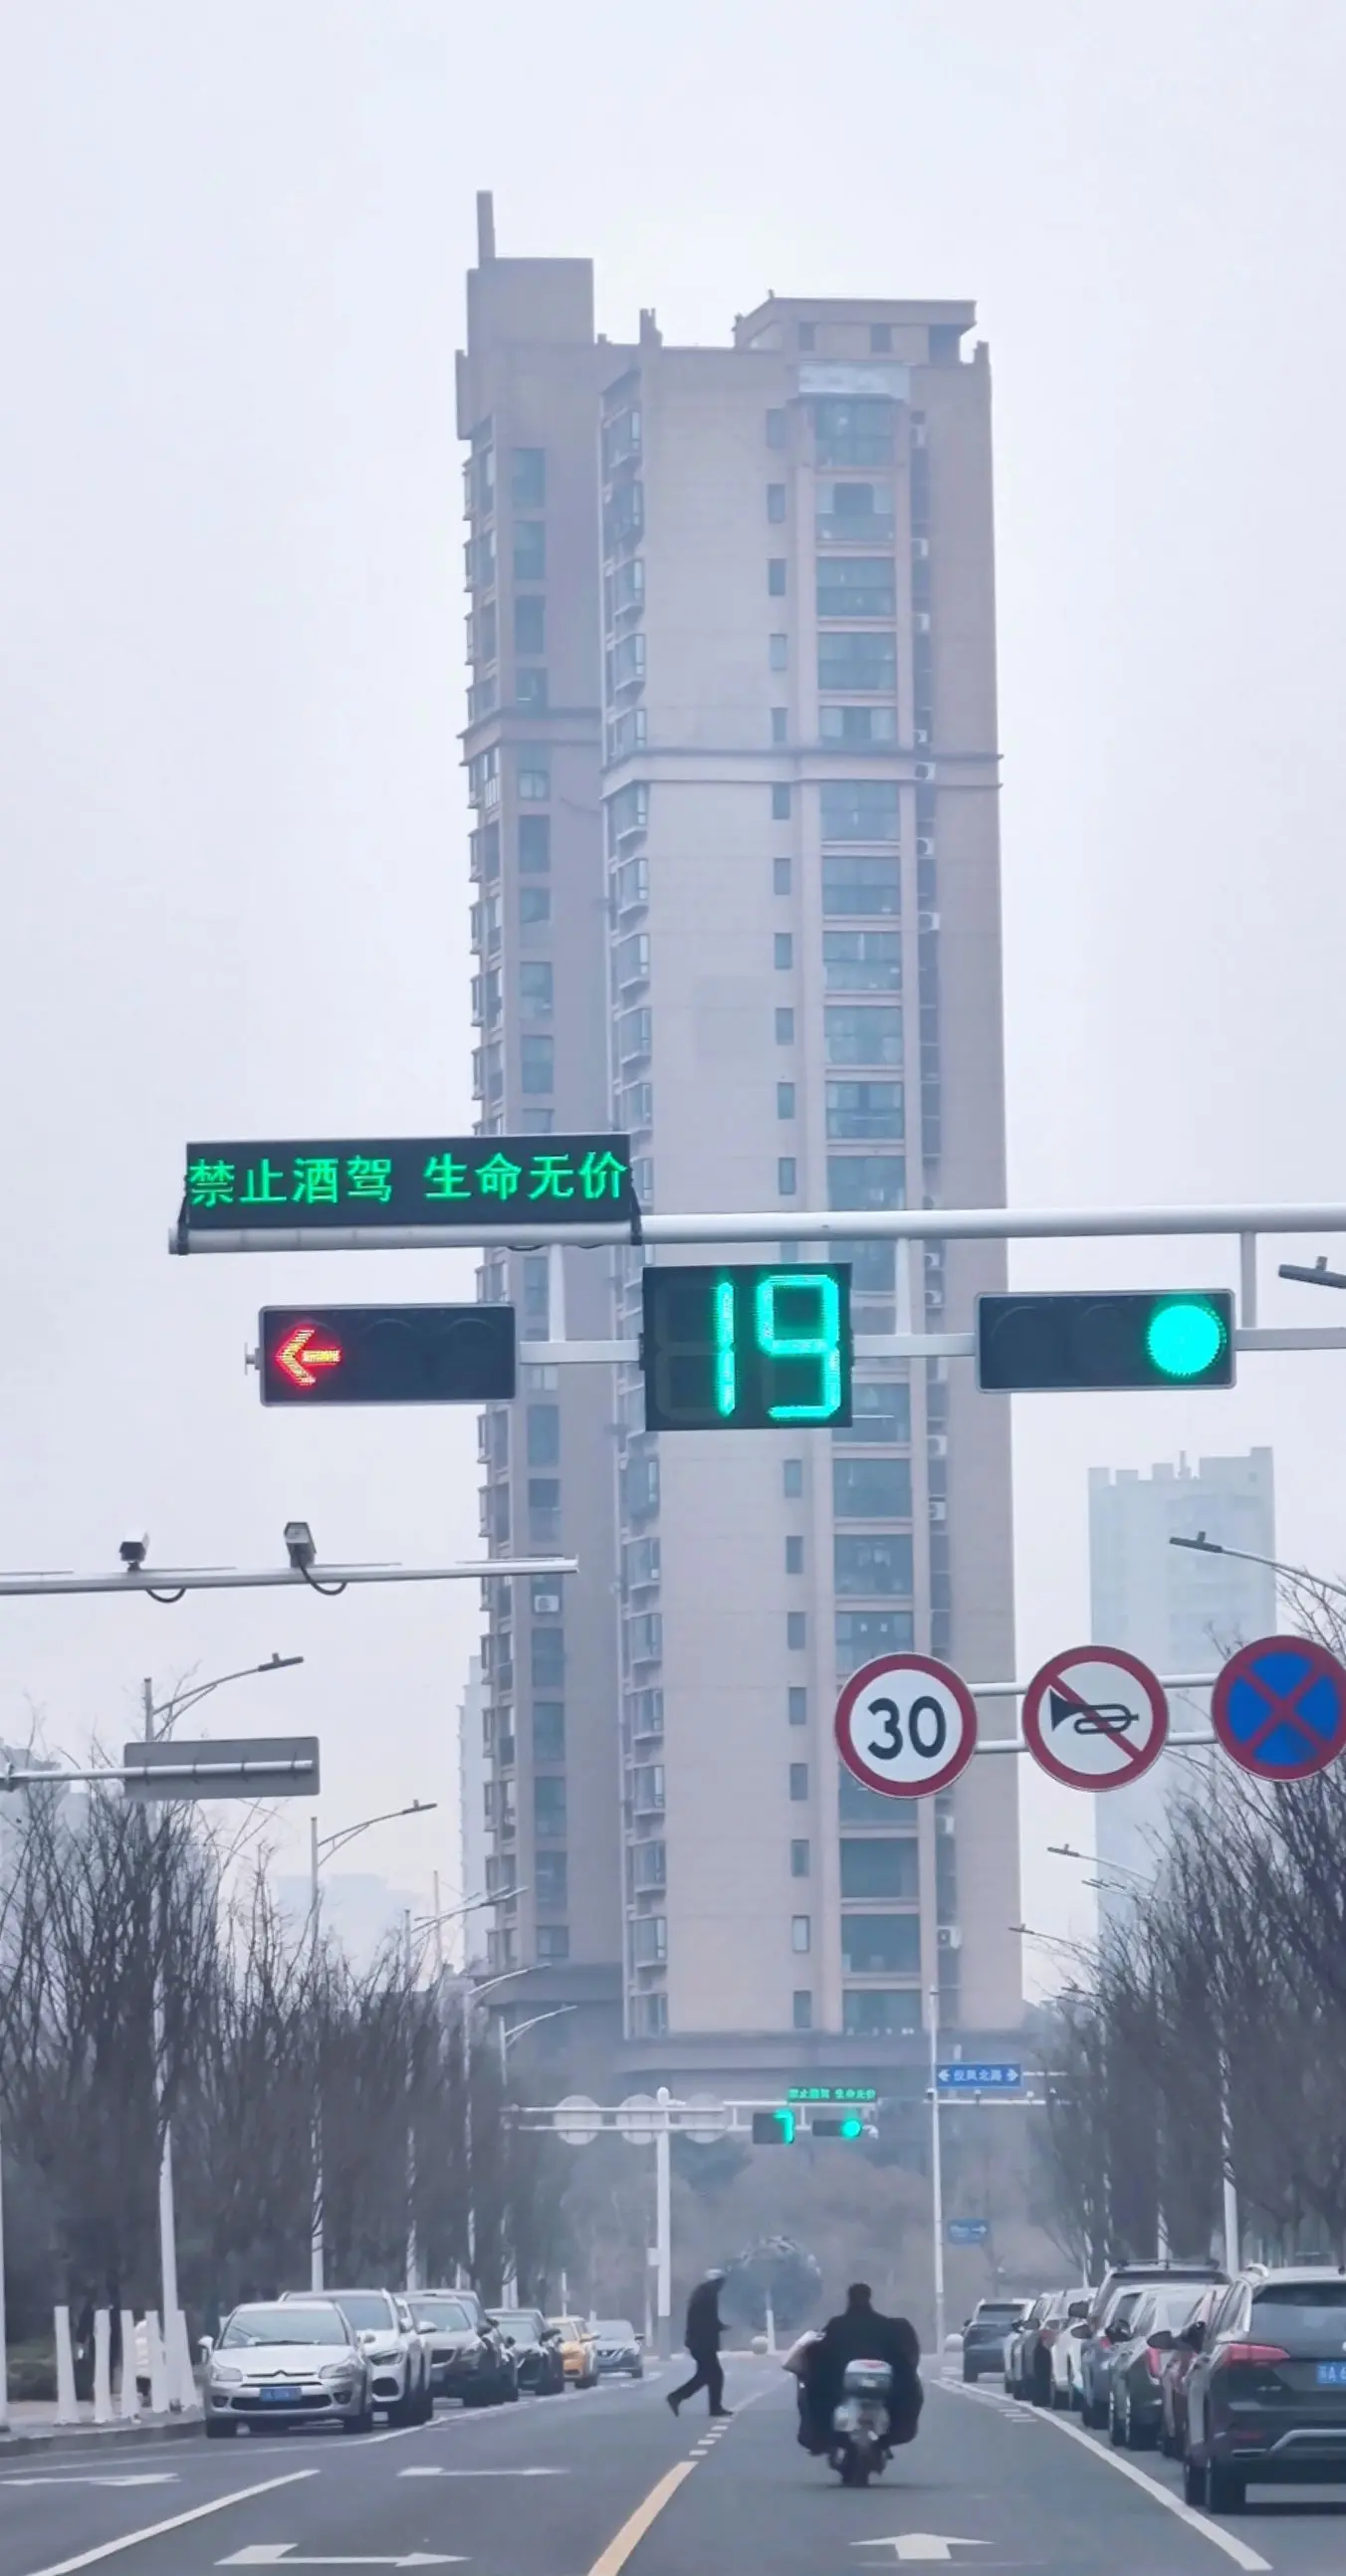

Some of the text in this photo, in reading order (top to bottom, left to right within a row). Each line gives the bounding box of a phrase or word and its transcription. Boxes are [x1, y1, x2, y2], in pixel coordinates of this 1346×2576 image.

[188, 1152, 628, 1207] 禁止酒驾 生命无价
[715, 1273, 841, 1419] 19
[867, 1694, 947, 1759] 30
